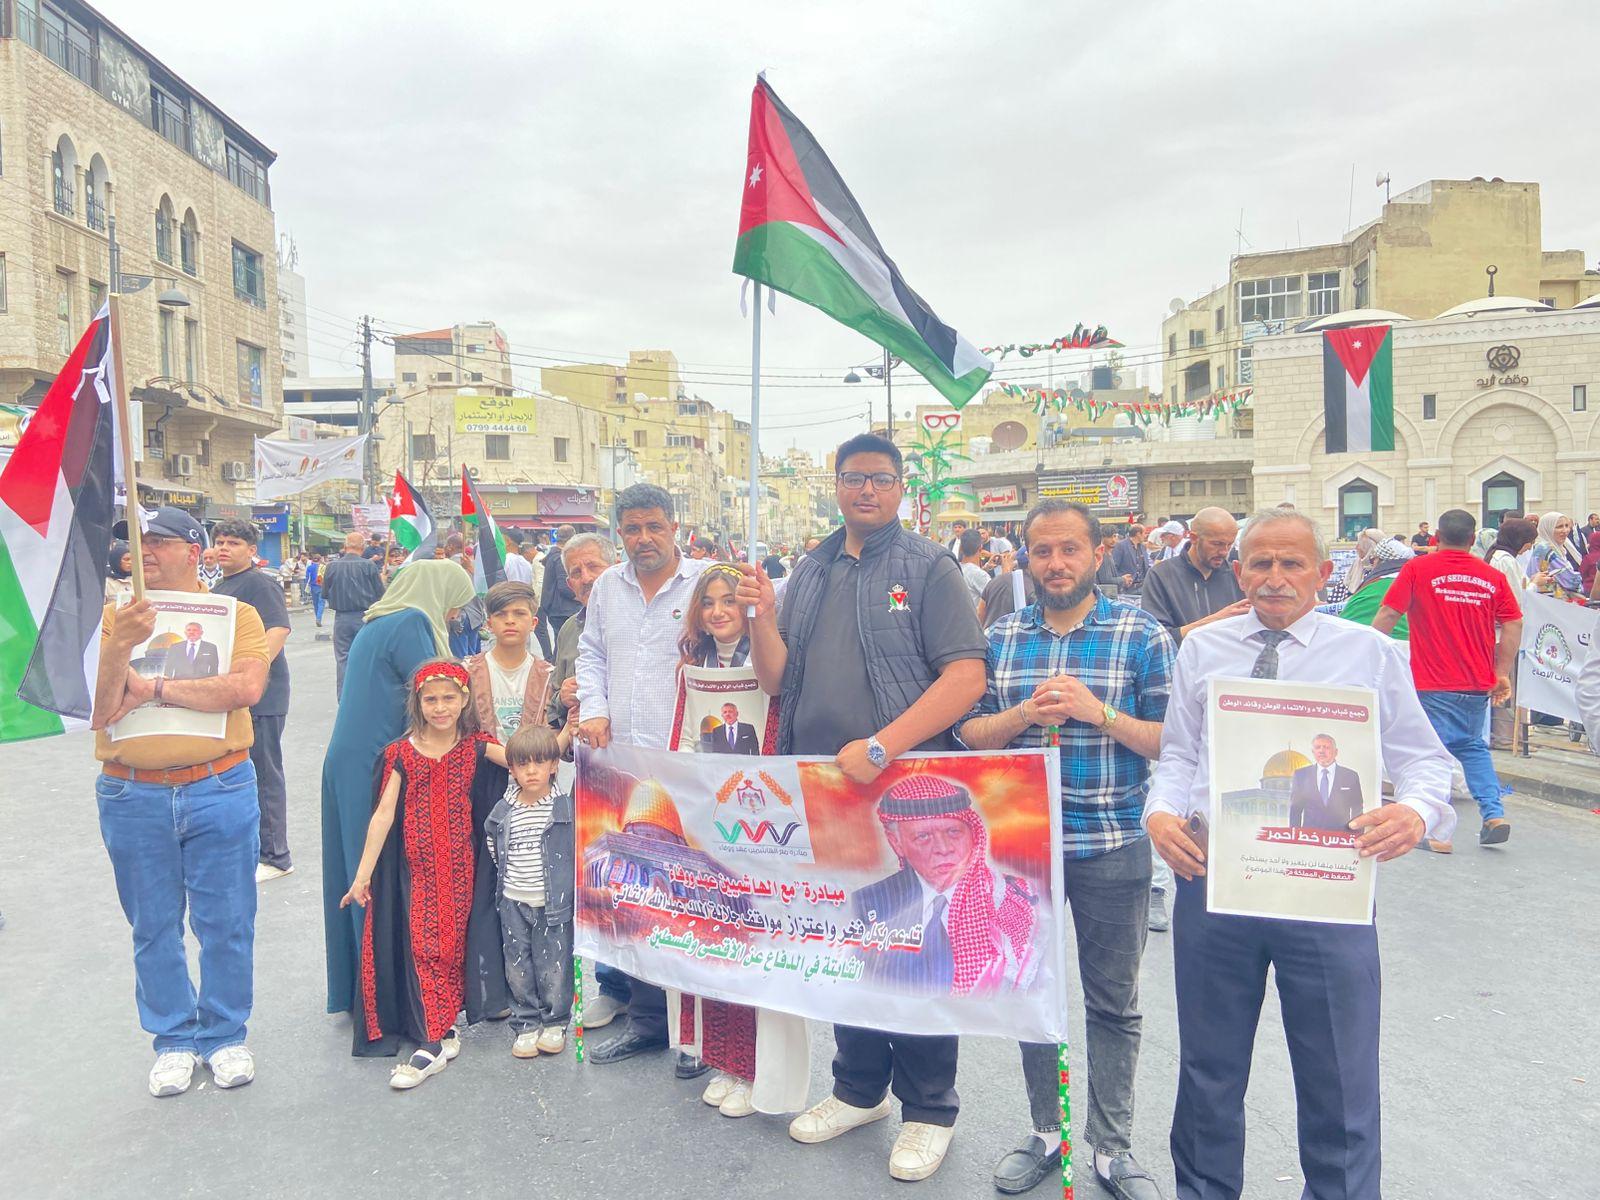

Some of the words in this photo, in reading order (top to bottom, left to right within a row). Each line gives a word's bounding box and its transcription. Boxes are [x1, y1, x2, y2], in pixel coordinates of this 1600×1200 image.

[479, 397, 514, 409] الموقع
[1431, 576, 1446, 587] STV
[1332, 708, 1348, 716] شباب
[1349, 709, 1365, 718] تجمع
[1267, 828, 1295, 840] أحمر
[1298, 829, 1319, 842] خط
[1322, 834, 1356, 845] قدس
[697, 872, 718, 891] عهد
[719, 873, 777, 897] الهاشميين
[803, 881, 845, 905] مبادرة
[787, 914, 836, 941] واعتزاز
[742, 945, 764, 967] عن
[804, 954, 820, 982] في
